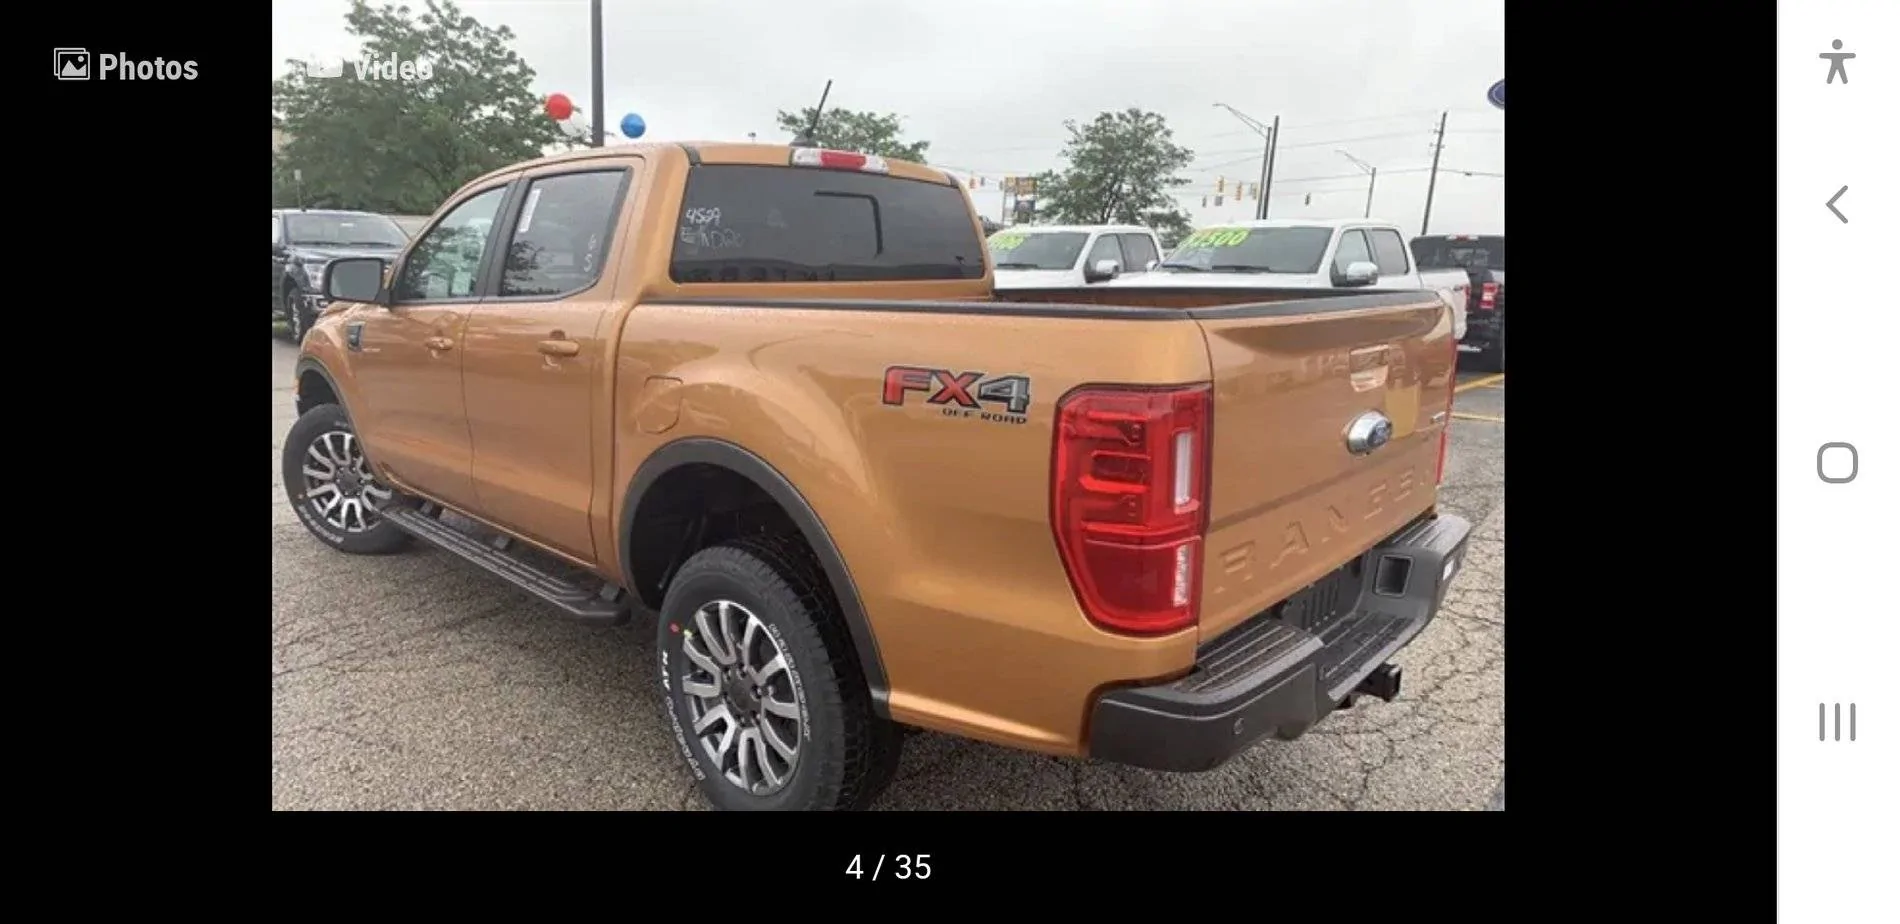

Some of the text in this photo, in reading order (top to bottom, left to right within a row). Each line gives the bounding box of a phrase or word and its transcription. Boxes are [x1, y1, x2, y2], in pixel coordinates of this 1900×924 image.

[882, 365, 1031, 413] FX4
[942, 407, 1027, 424] OFF ROAD
[1212, 465, 1432, 594] RANGE
